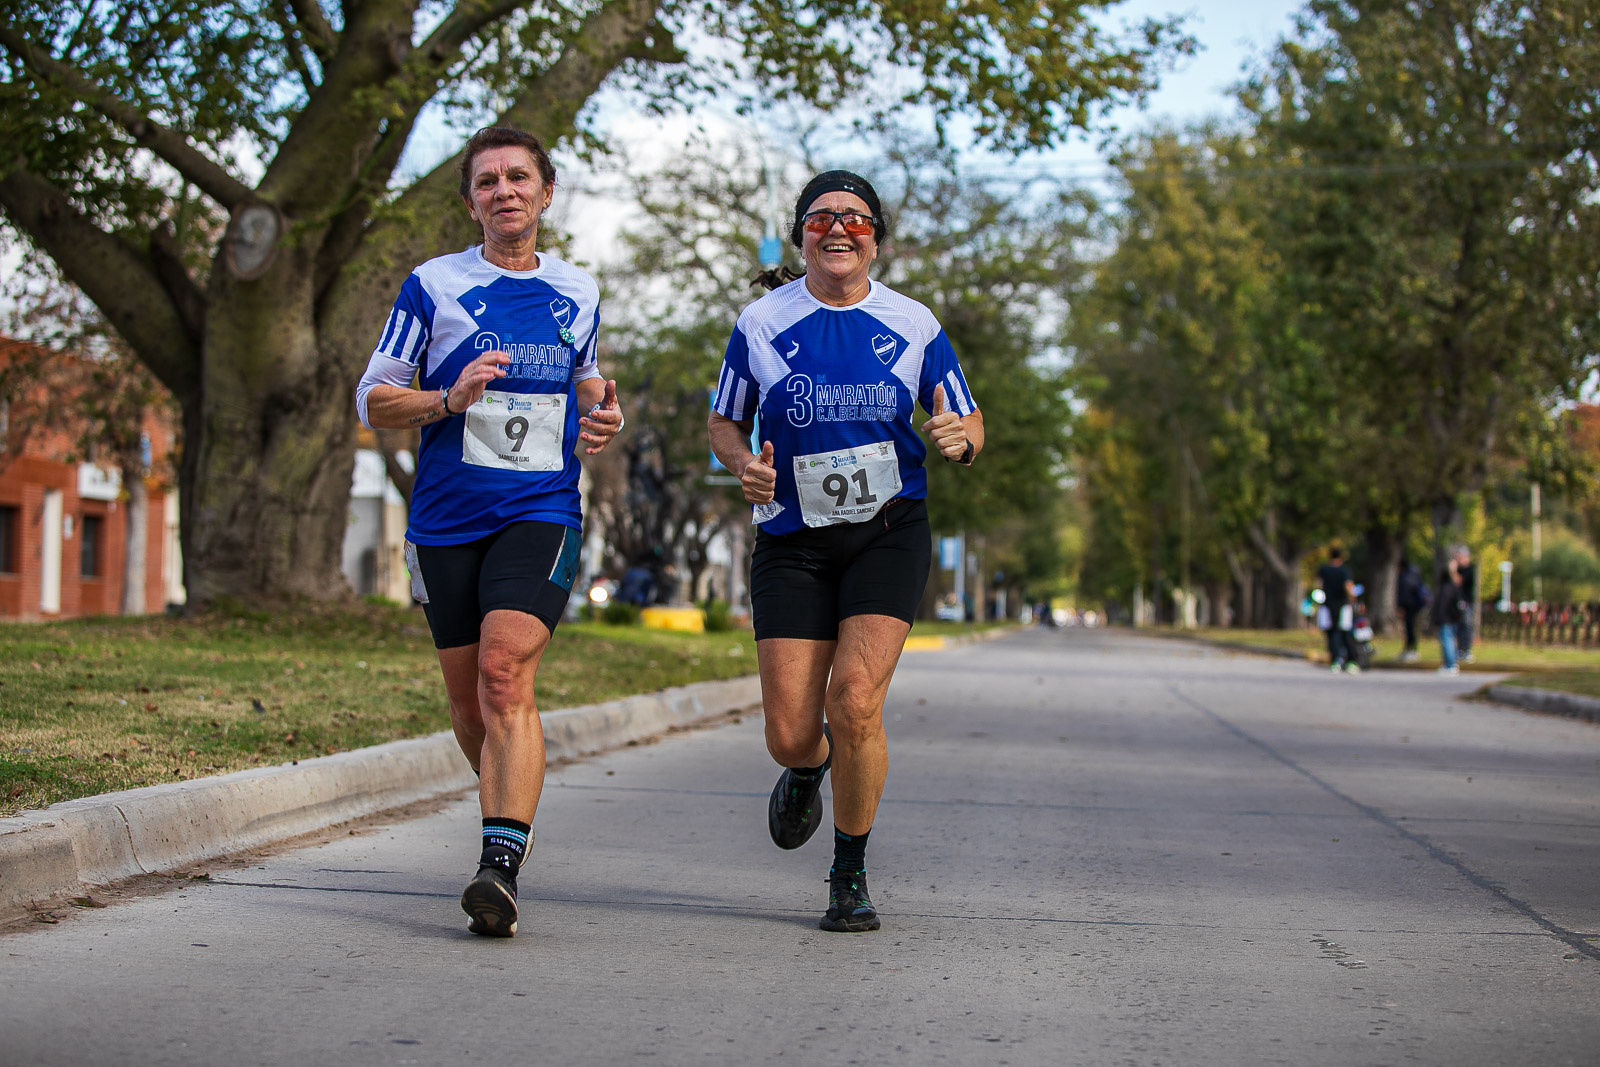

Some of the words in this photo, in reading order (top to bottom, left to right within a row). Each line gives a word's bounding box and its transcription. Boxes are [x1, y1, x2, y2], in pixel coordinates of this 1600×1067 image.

[503, 342, 571, 368] MARATÓN
[786, 373, 813, 428] 3
[816, 381, 897, 407] MARATÓN
[504, 415, 530, 452] 9
[821, 467, 877, 507] 91
